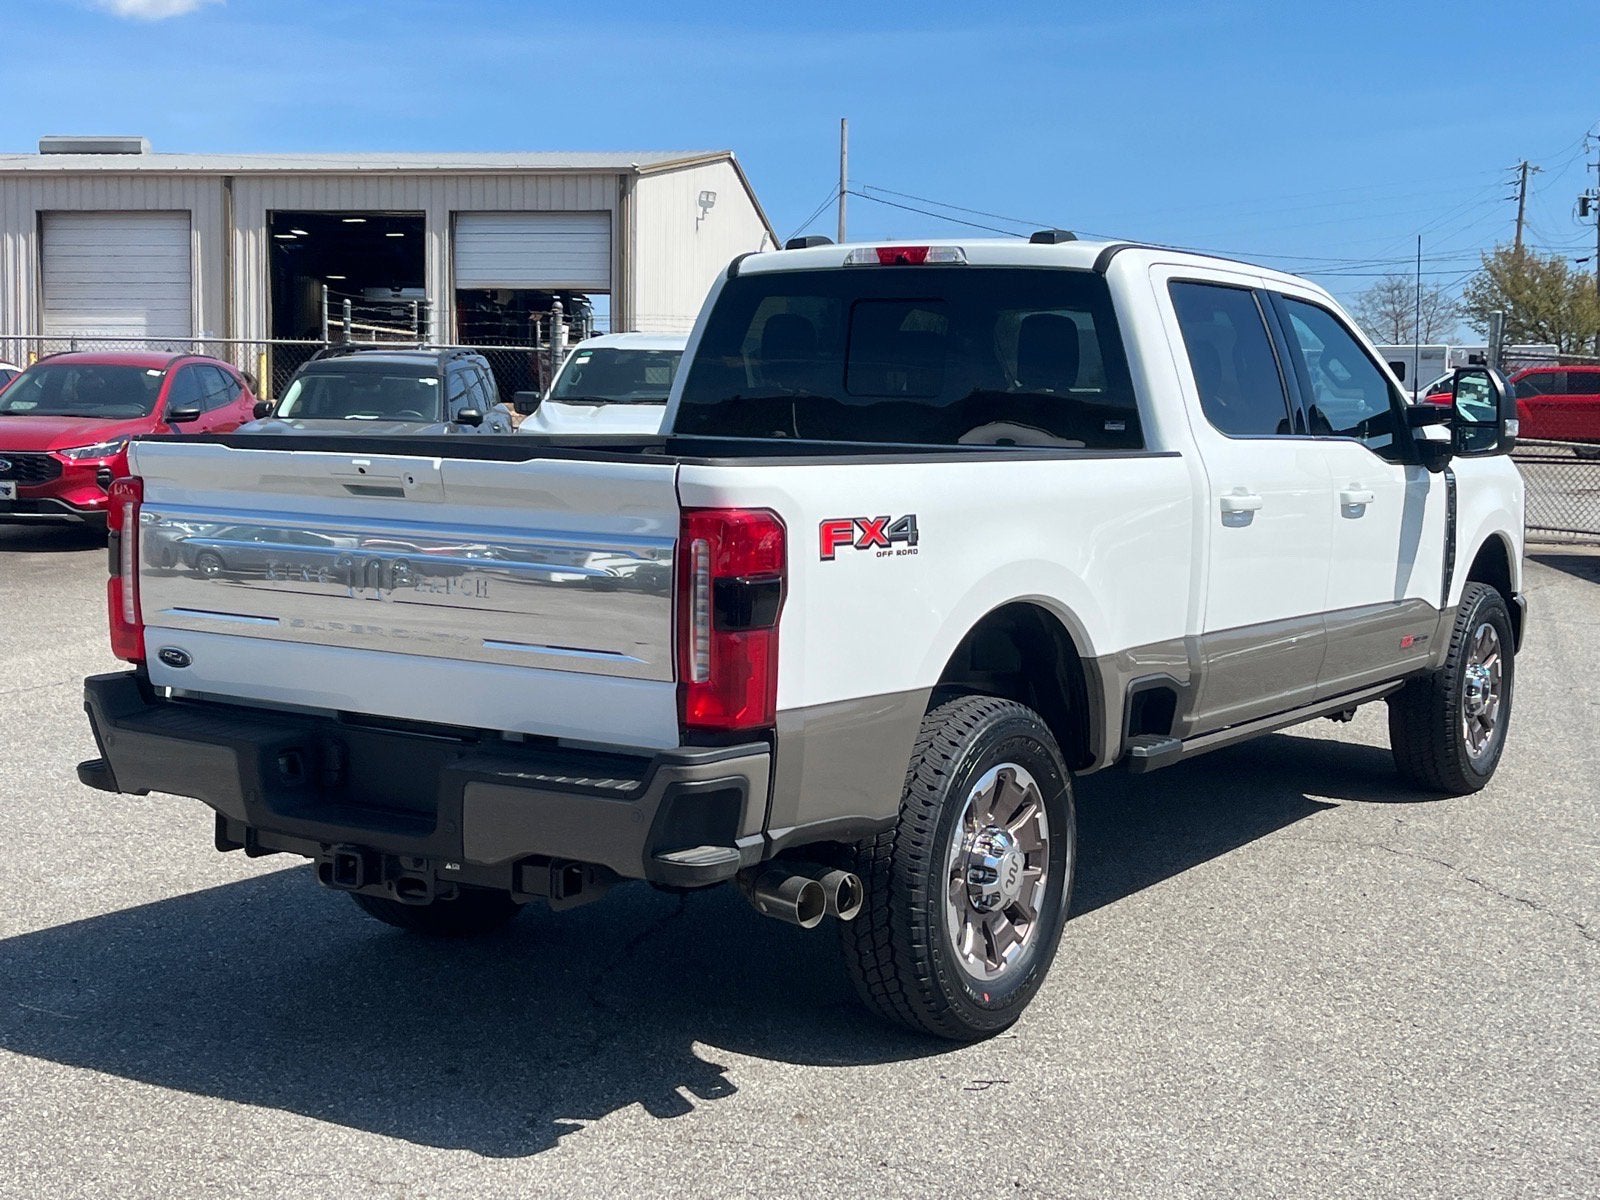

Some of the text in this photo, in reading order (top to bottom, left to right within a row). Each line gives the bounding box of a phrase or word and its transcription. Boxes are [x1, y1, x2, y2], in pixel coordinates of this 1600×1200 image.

[819, 514, 919, 561] FX4
[876, 548, 919, 558] OFF ROAD
